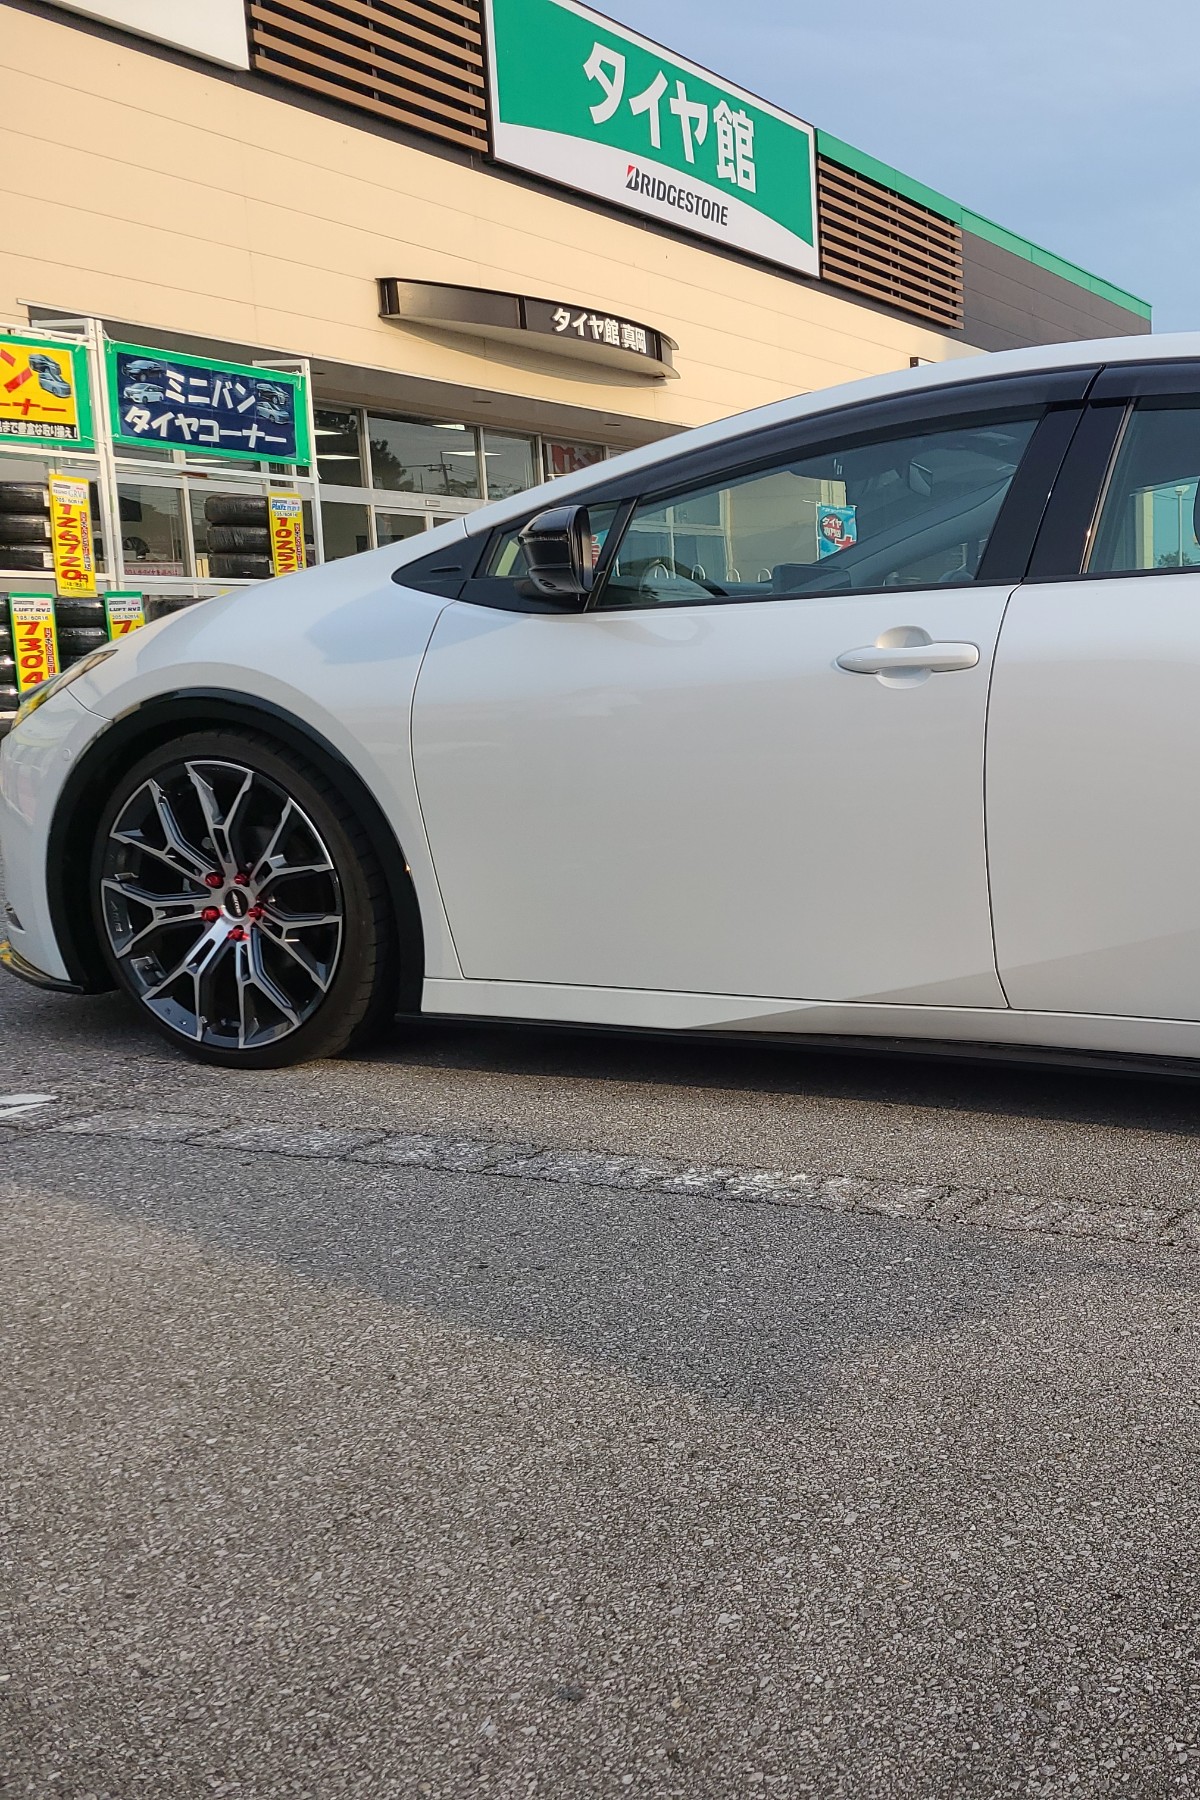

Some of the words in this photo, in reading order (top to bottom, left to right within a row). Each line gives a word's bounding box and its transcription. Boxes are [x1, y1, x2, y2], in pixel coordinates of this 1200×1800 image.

[582, 41, 757, 194] タイヤ館
[625, 164, 729, 227] BRIDGESTONE
[551, 308, 620, 346] タイヤ館
[165, 370, 256, 413] ミニバン
[125, 405, 287, 448] タイヤコーナー
